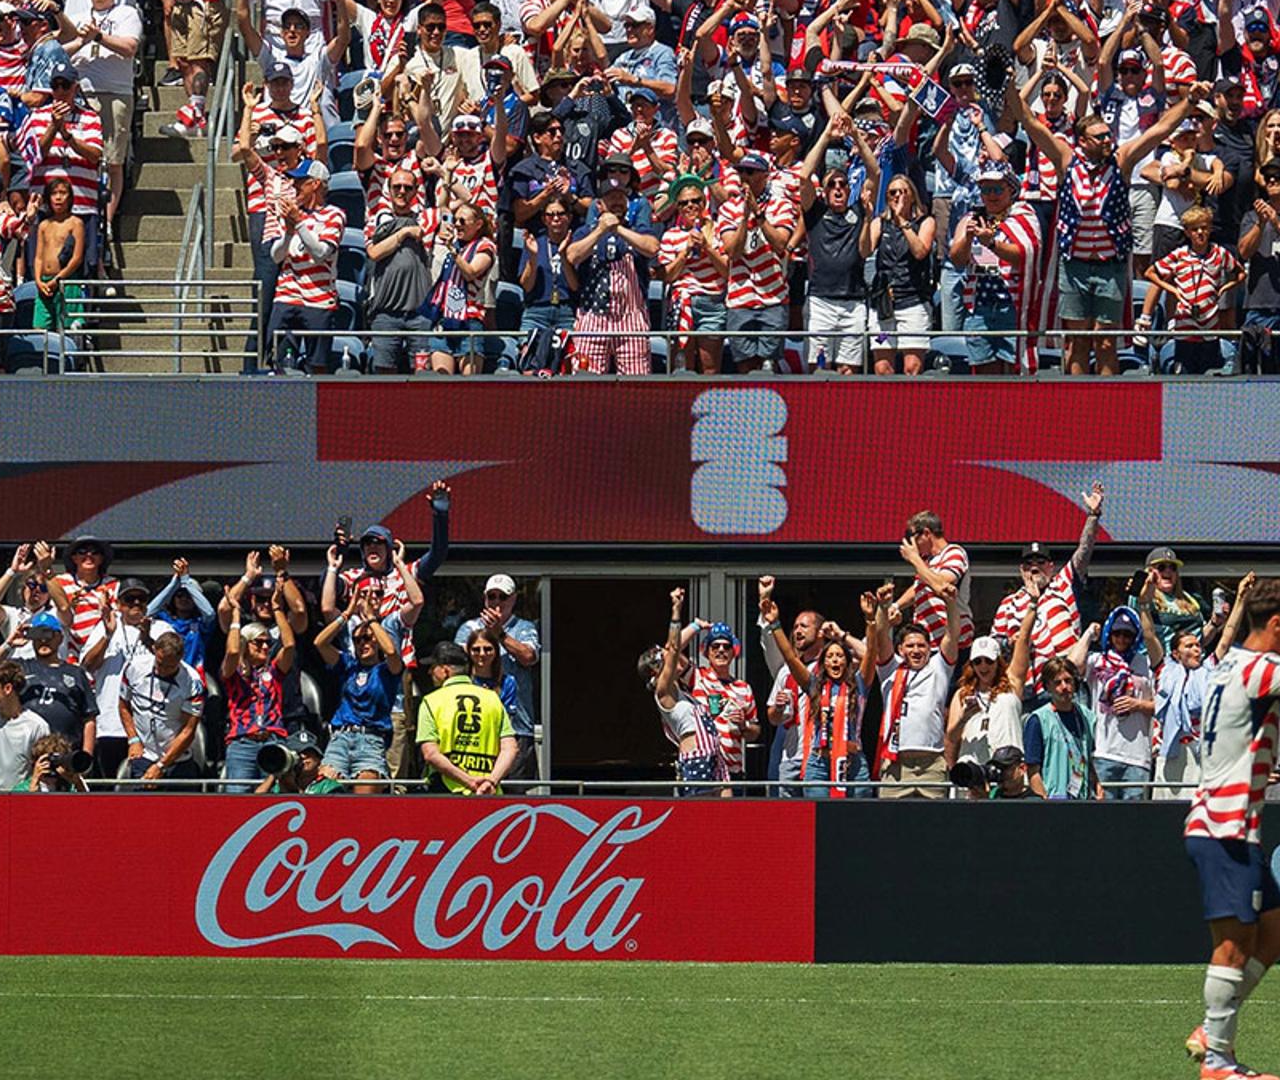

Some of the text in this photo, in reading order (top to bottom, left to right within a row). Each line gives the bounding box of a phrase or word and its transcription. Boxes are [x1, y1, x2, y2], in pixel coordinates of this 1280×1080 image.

[39, 687, 56, 705] 15
[453, 754, 493, 772] CURITY
[195, 801, 674, 953] Coca-Cola
